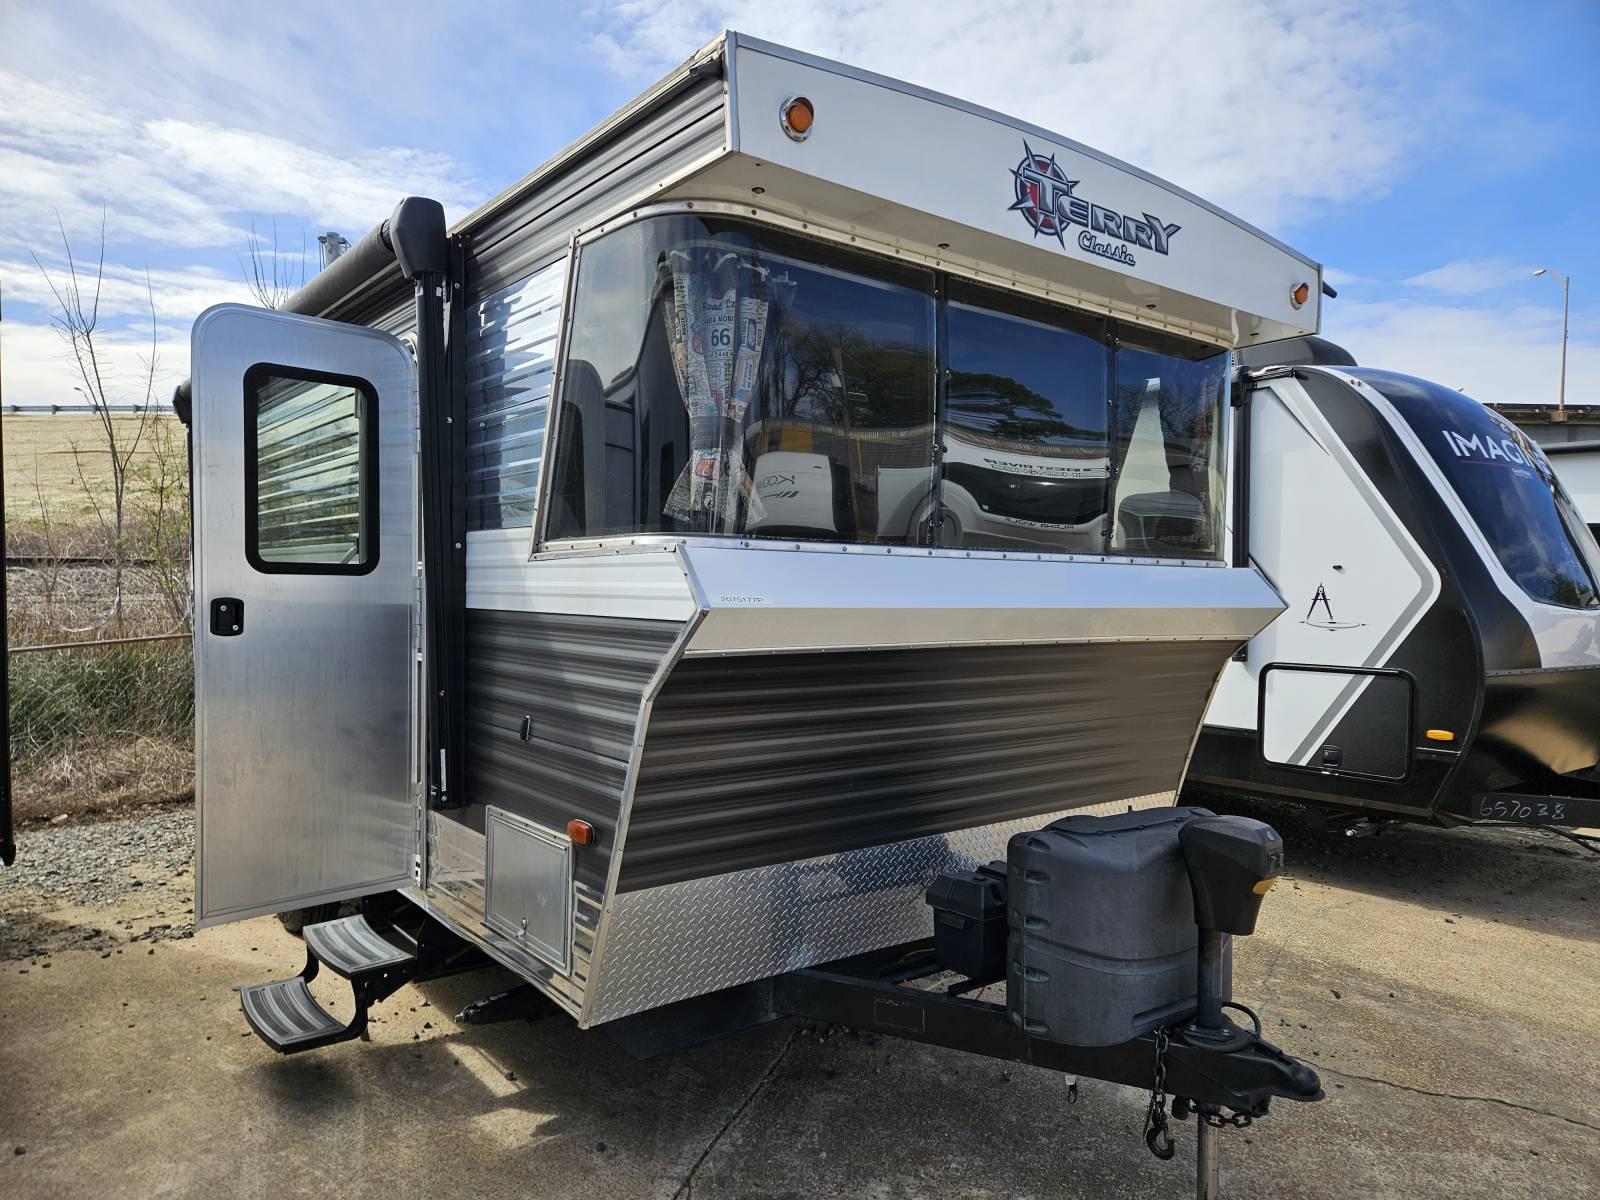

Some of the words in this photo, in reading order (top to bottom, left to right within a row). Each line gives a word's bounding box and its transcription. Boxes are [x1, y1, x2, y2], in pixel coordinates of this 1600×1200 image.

[1022, 166, 1183, 256] TERRY
[1078, 230, 1137, 267] Classic
[711, 328, 731, 347] 66
